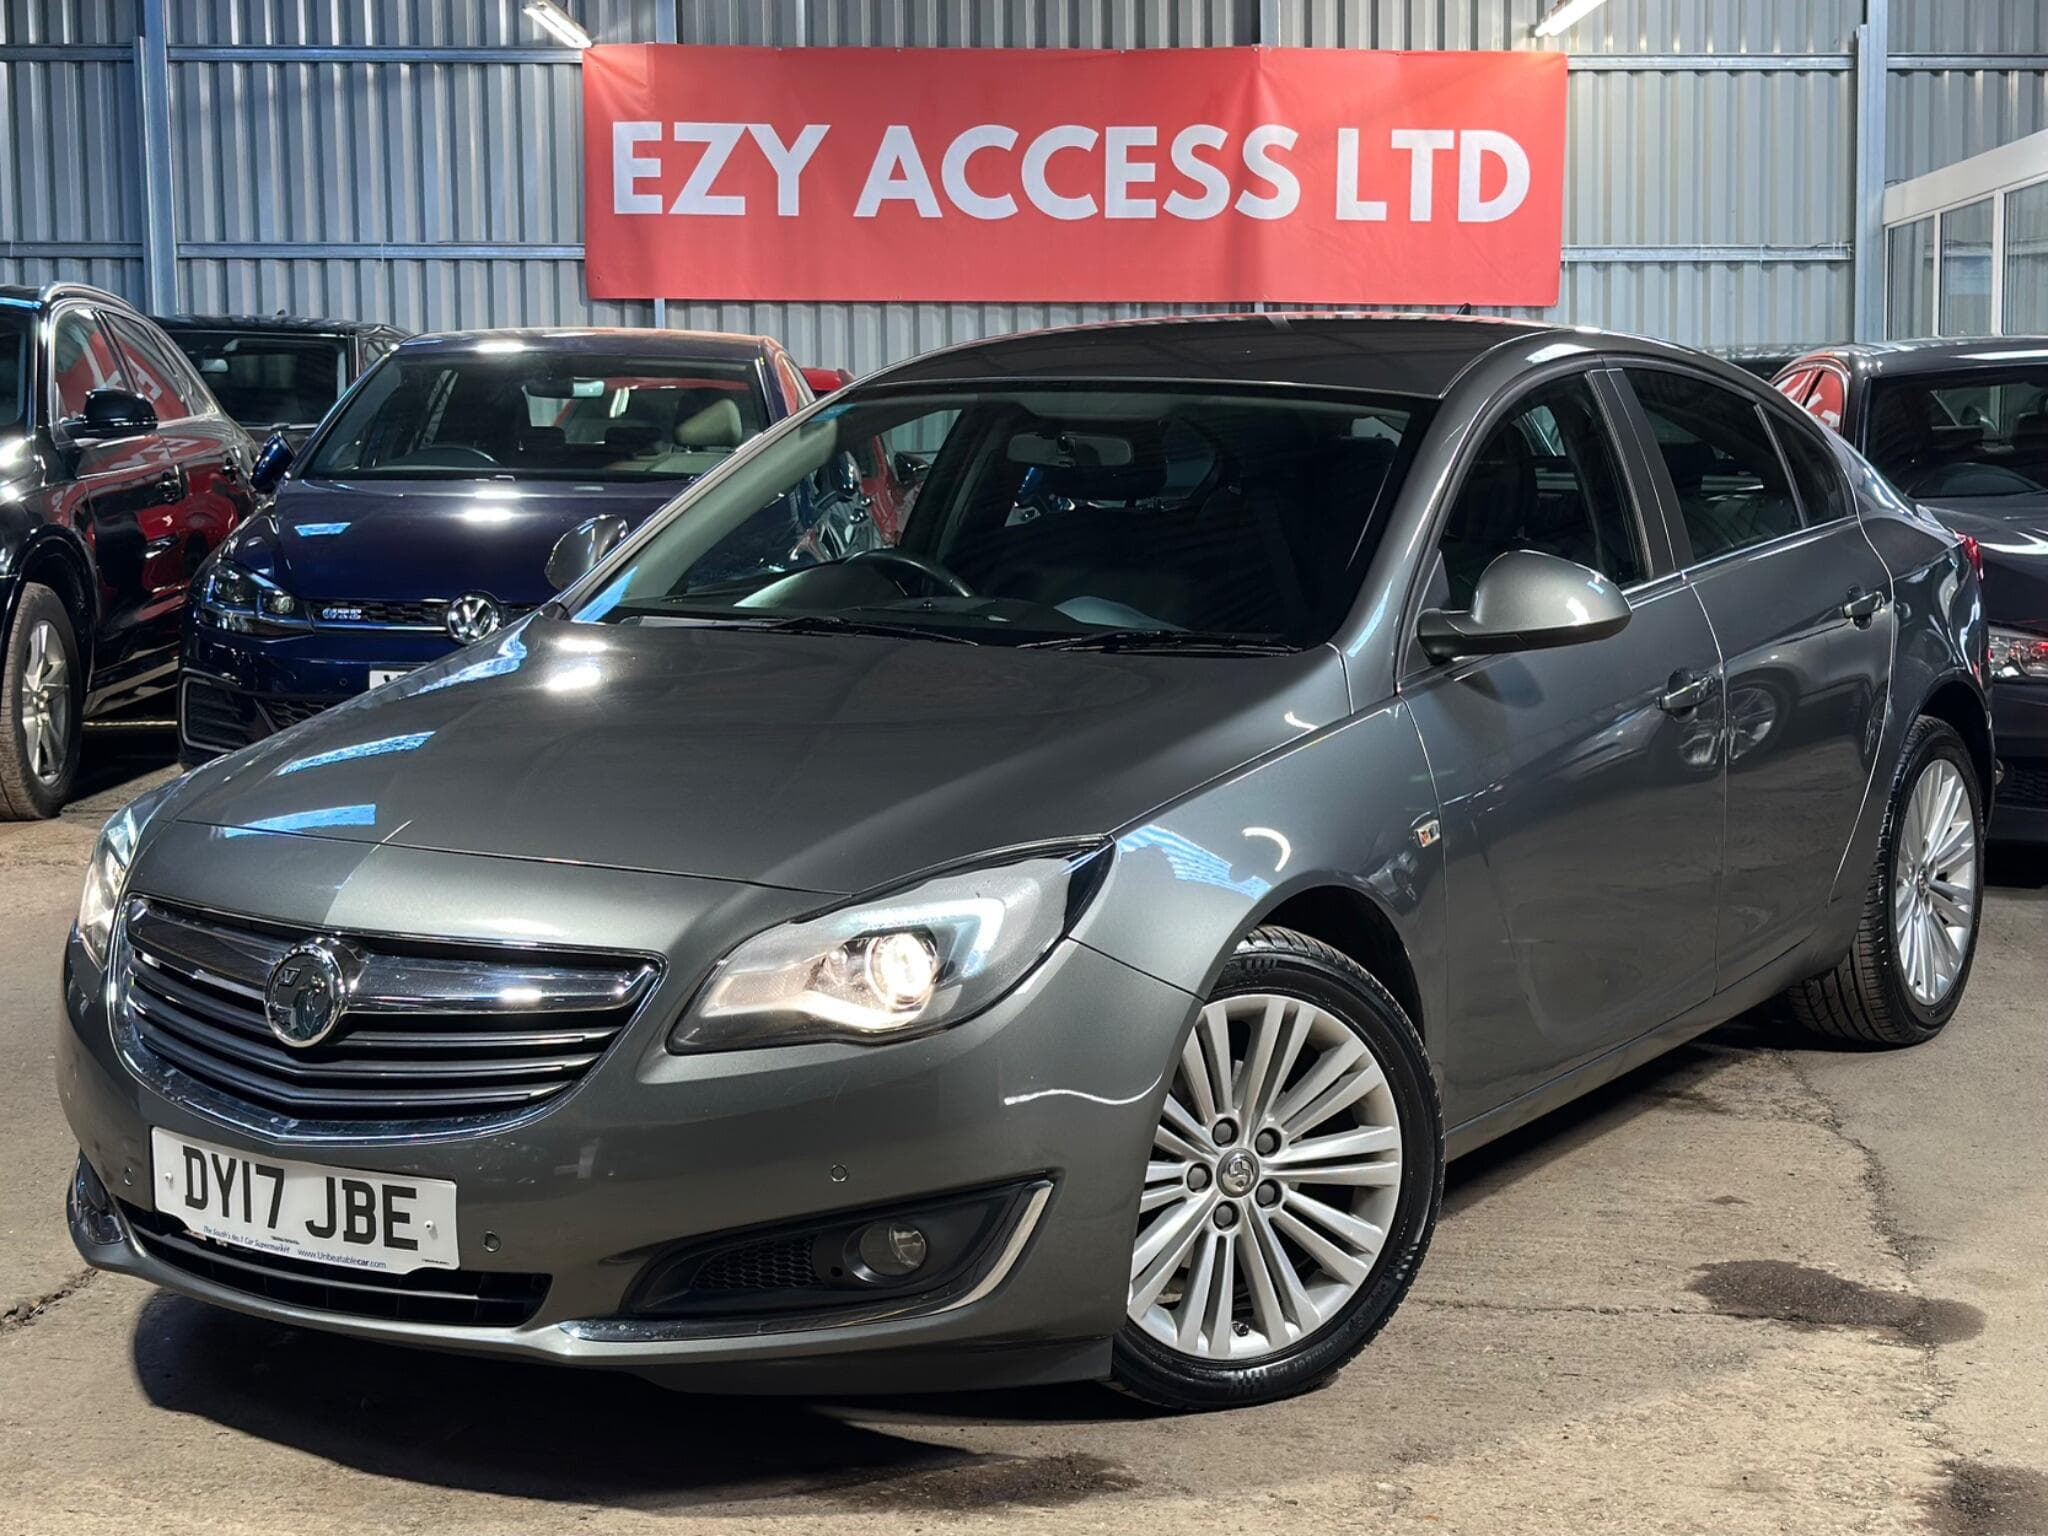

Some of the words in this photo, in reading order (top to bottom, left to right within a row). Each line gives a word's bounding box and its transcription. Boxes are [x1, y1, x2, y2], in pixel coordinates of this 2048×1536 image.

[612, 120, 831, 217] EZY
[852, 123, 1302, 221] ACCESS
[1335, 127, 1531, 223] LTD
[182, 1145, 285, 1229] DY17
[305, 1175, 419, 1251] JBE
[254, 1239, 290, 1253] Supermarket
[297, 1248, 387, 1269] www.Unbeatablecar.com
